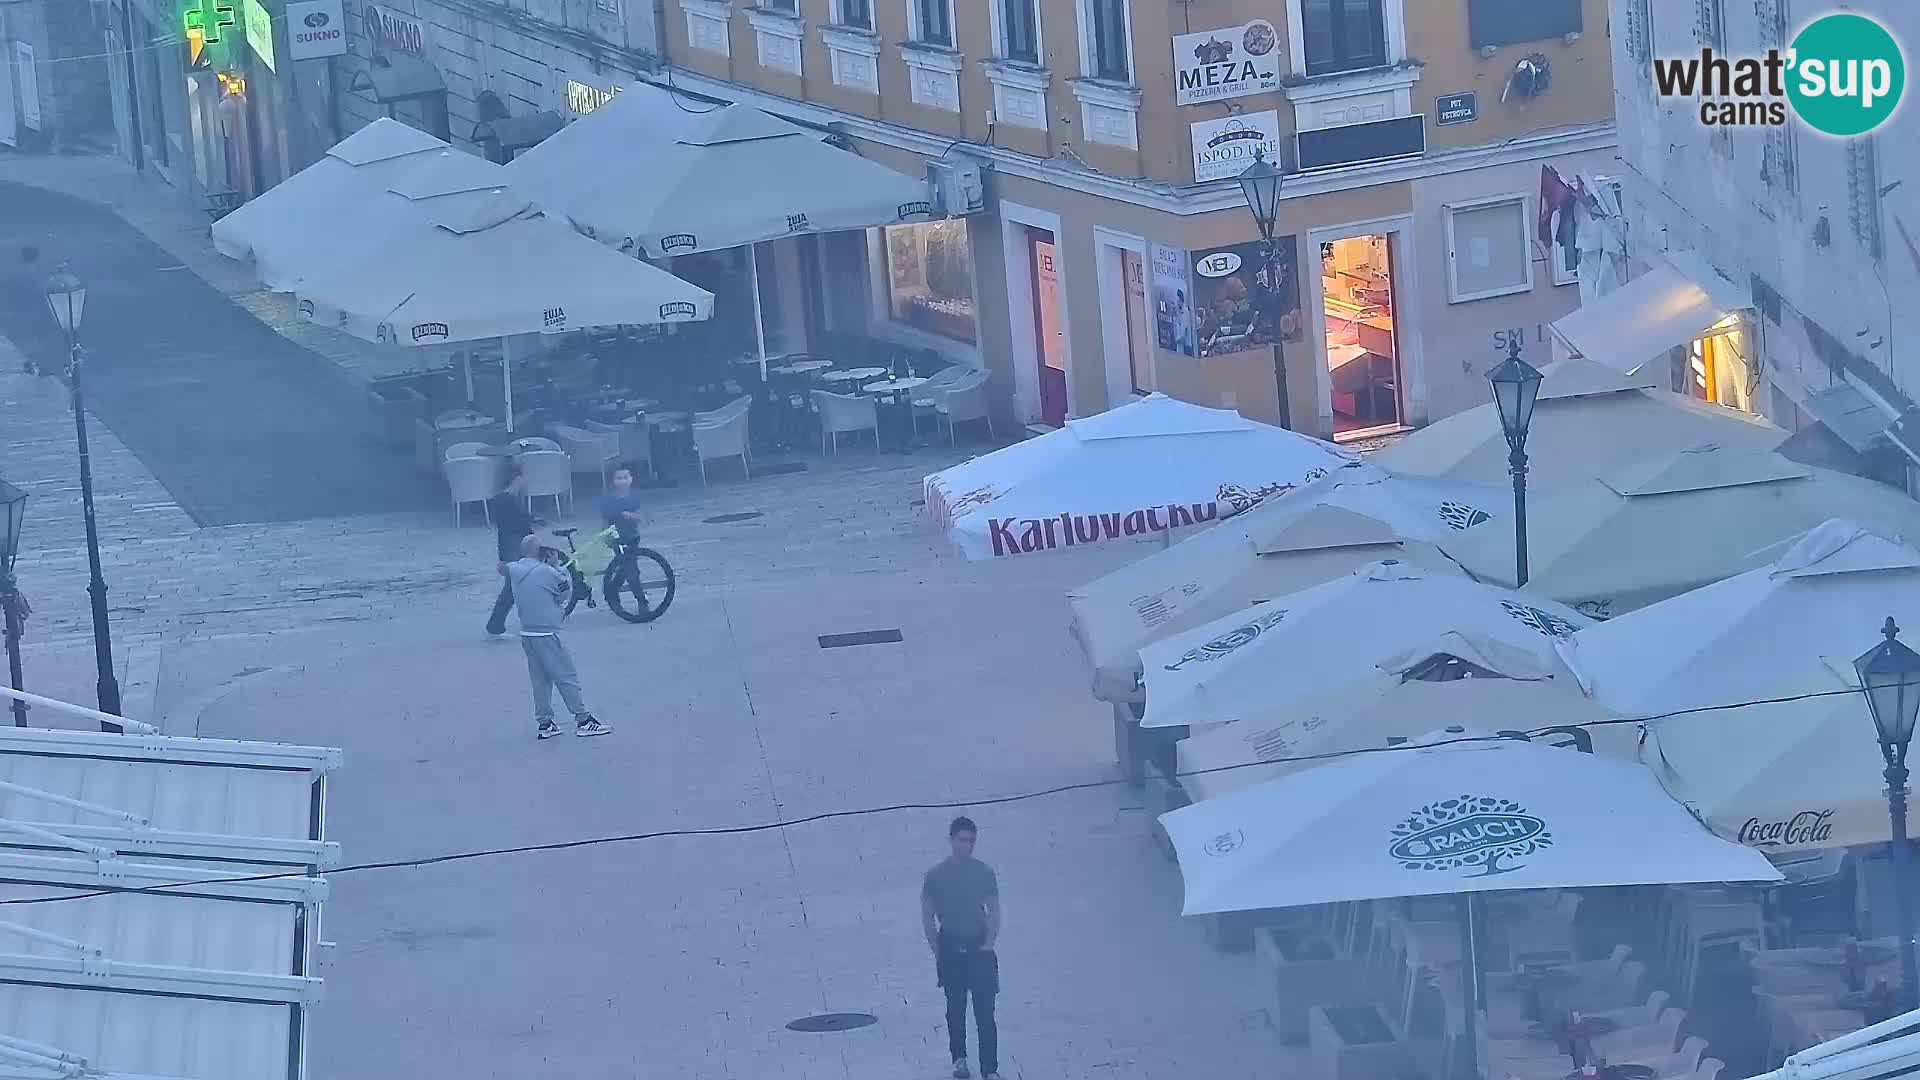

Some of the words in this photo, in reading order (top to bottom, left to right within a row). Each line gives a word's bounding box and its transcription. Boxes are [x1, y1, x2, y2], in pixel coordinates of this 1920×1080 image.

[296, 29, 341, 43] SUKNO
[382, 13, 423, 53] SUKNO
[1179, 60, 1258, 90] MEZA
[1189, 86, 1221, 98] PIZZERIA
[1229, 82, 1250, 93] GRILL
[1198, 146, 1243, 164] ISPOD
[1248, 140, 1277, 156] URE
[988, 501, 1217, 557] Karlovačko
[1429, 819, 1528, 850] RAUCH
